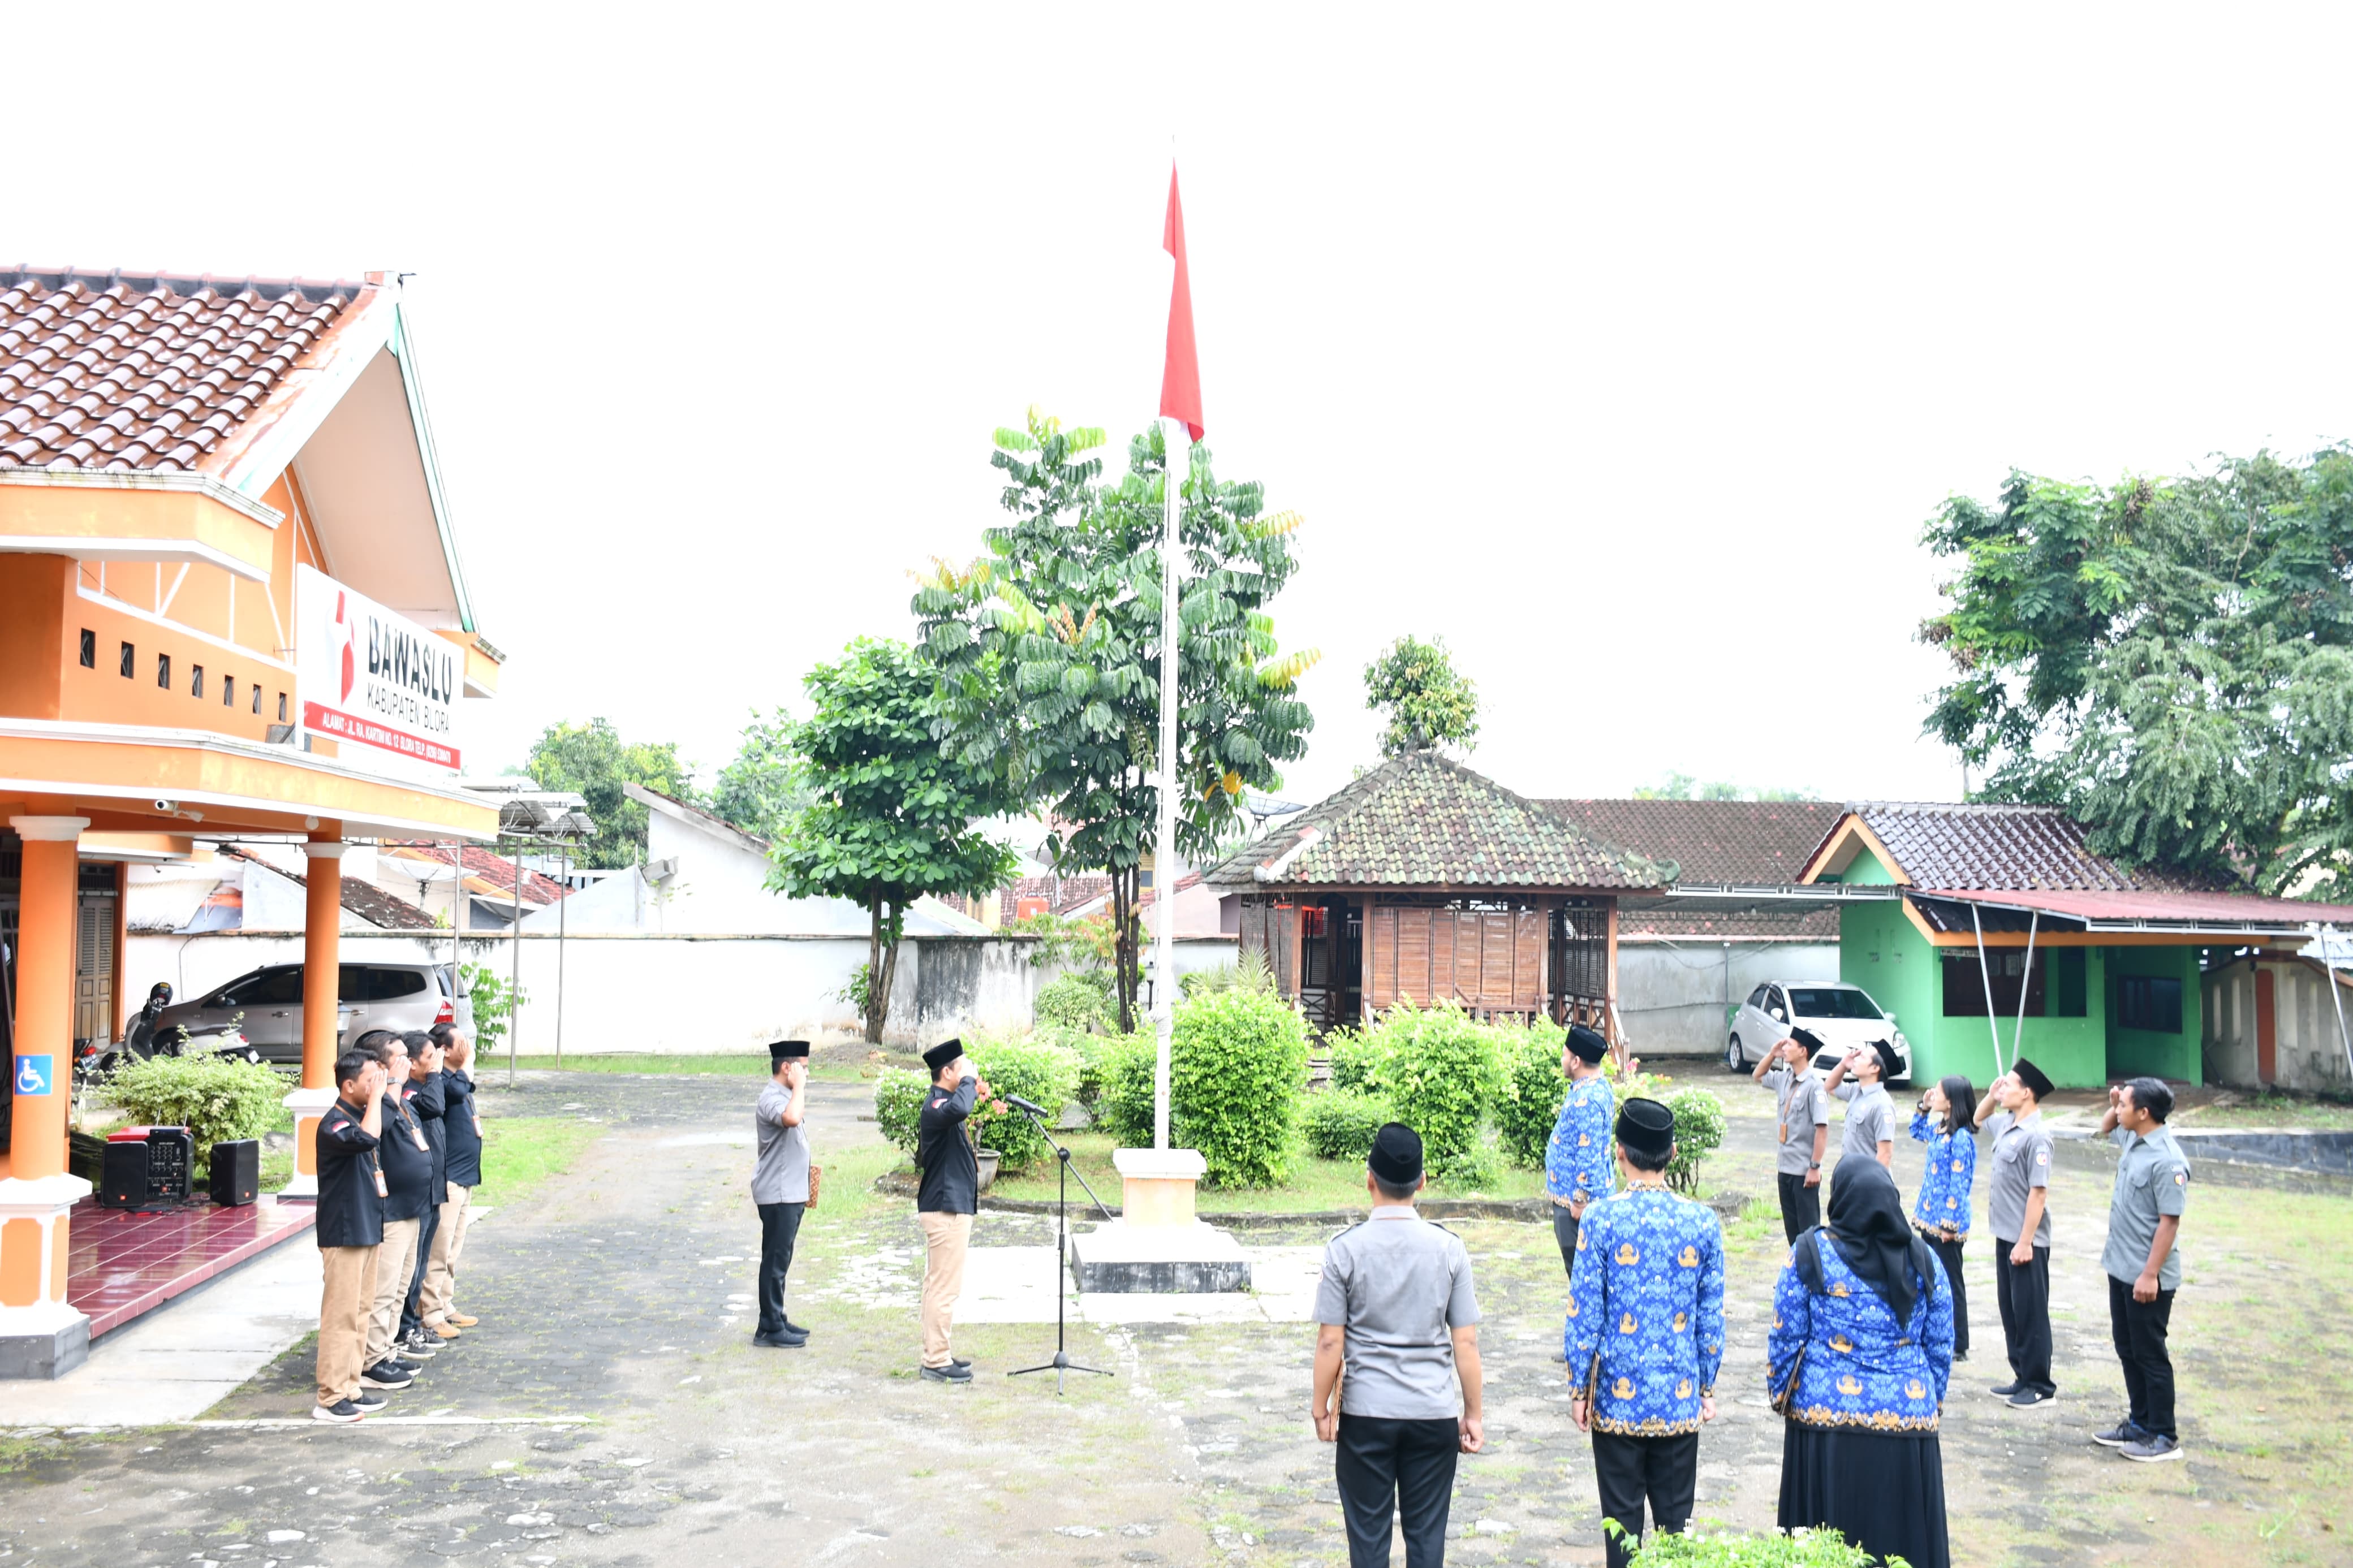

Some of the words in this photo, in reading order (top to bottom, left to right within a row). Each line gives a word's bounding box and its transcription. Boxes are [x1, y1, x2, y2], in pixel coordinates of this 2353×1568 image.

[369, 615, 452, 706] BAWASLU
[322, 711, 344, 732] ALAMAT
[347, 720, 356, 736] JL.
[356, 722, 365, 738] RA.
[365, 725, 385, 744] KARTINI
[393, 734, 399, 748] 12
[399, 736, 415, 753] BLORA
[415, 740, 426, 756] TELP.
[367, 682, 420, 725] KABUPATEN
[424, 705, 450, 736] BLORA
